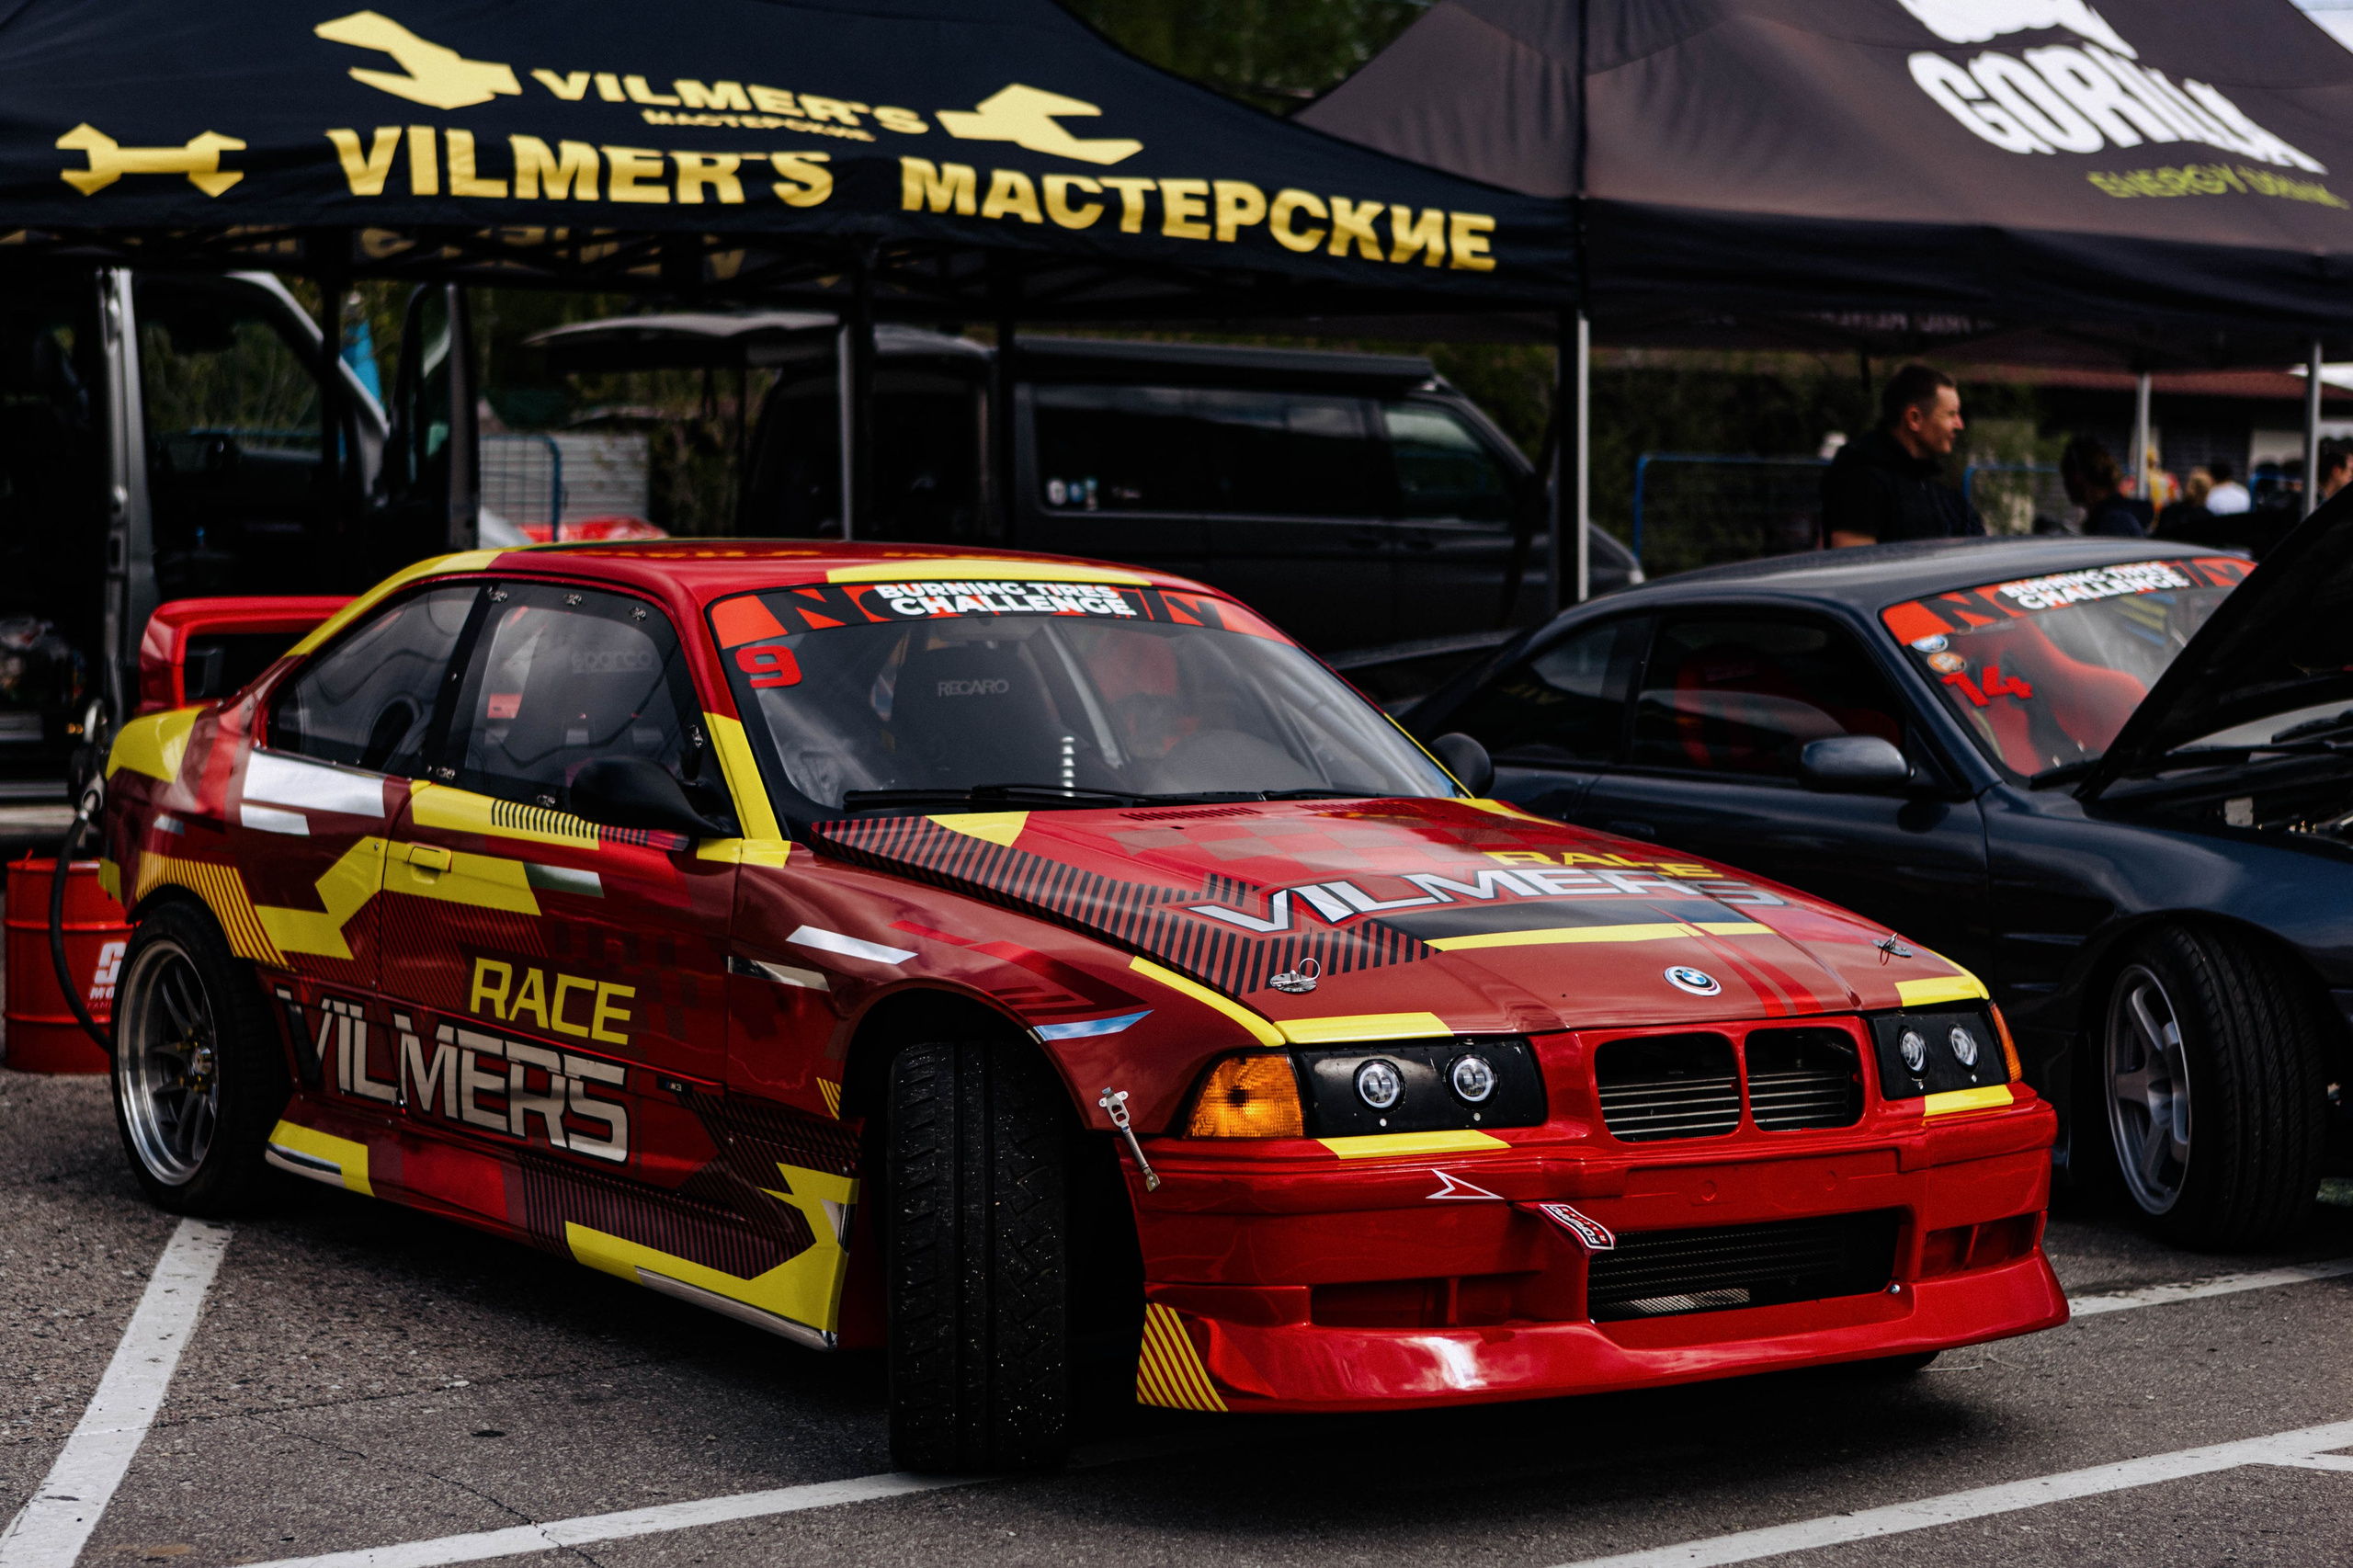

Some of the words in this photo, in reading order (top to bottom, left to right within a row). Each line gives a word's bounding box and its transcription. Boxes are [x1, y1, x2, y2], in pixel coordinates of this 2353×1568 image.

[1907, 41, 2328, 175] GORILLA
[899, 156, 1496, 272] МАСТЕРСКИЕ
[873, 582, 1028, 599] BURNING
[1026, 583, 1120, 599] TIRES
[890, 595, 1138, 617] CHALLENGE
[2018, 574, 2190, 609] CHALLENGE
[735, 645, 802, 689] 9
[938, 678, 1010, 697] RECARO
[1940, 665, 2033, 707] 14
[1188, 868, 1786, 933] VILMERS
[470, 956, 636, 1045] RACE
[276, 987, 630, 1164] VILMERS
[668, 1082, 682, 1092] M3
